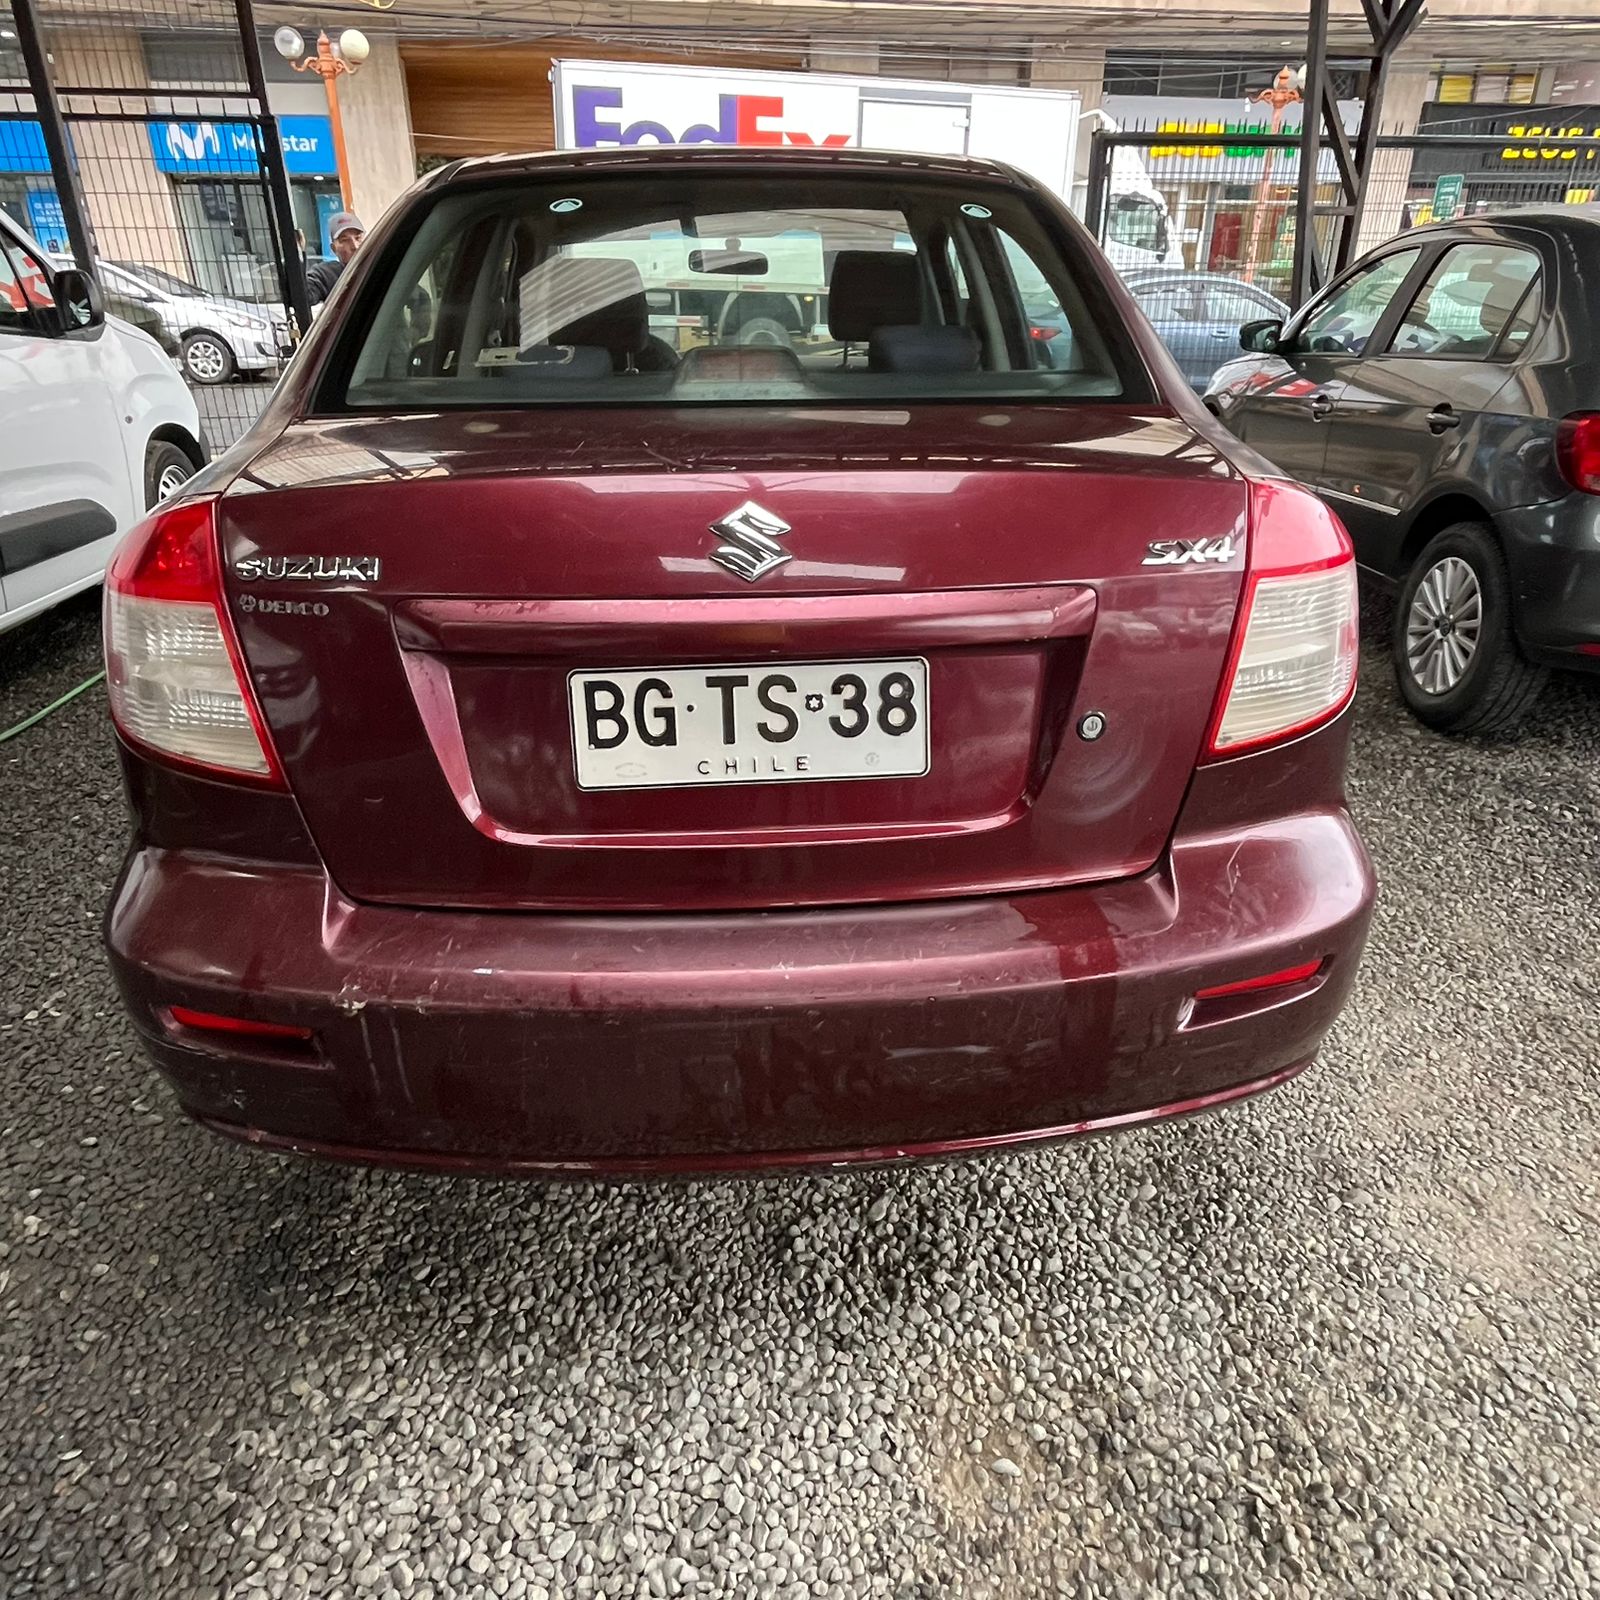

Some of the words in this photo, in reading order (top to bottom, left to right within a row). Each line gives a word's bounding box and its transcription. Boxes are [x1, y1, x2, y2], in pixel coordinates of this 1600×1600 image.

[1141, 536, 1237, 566] SX4
[236, 556, 381, 581] SUZUKI
[697, 756, 809, 775] CHILE
